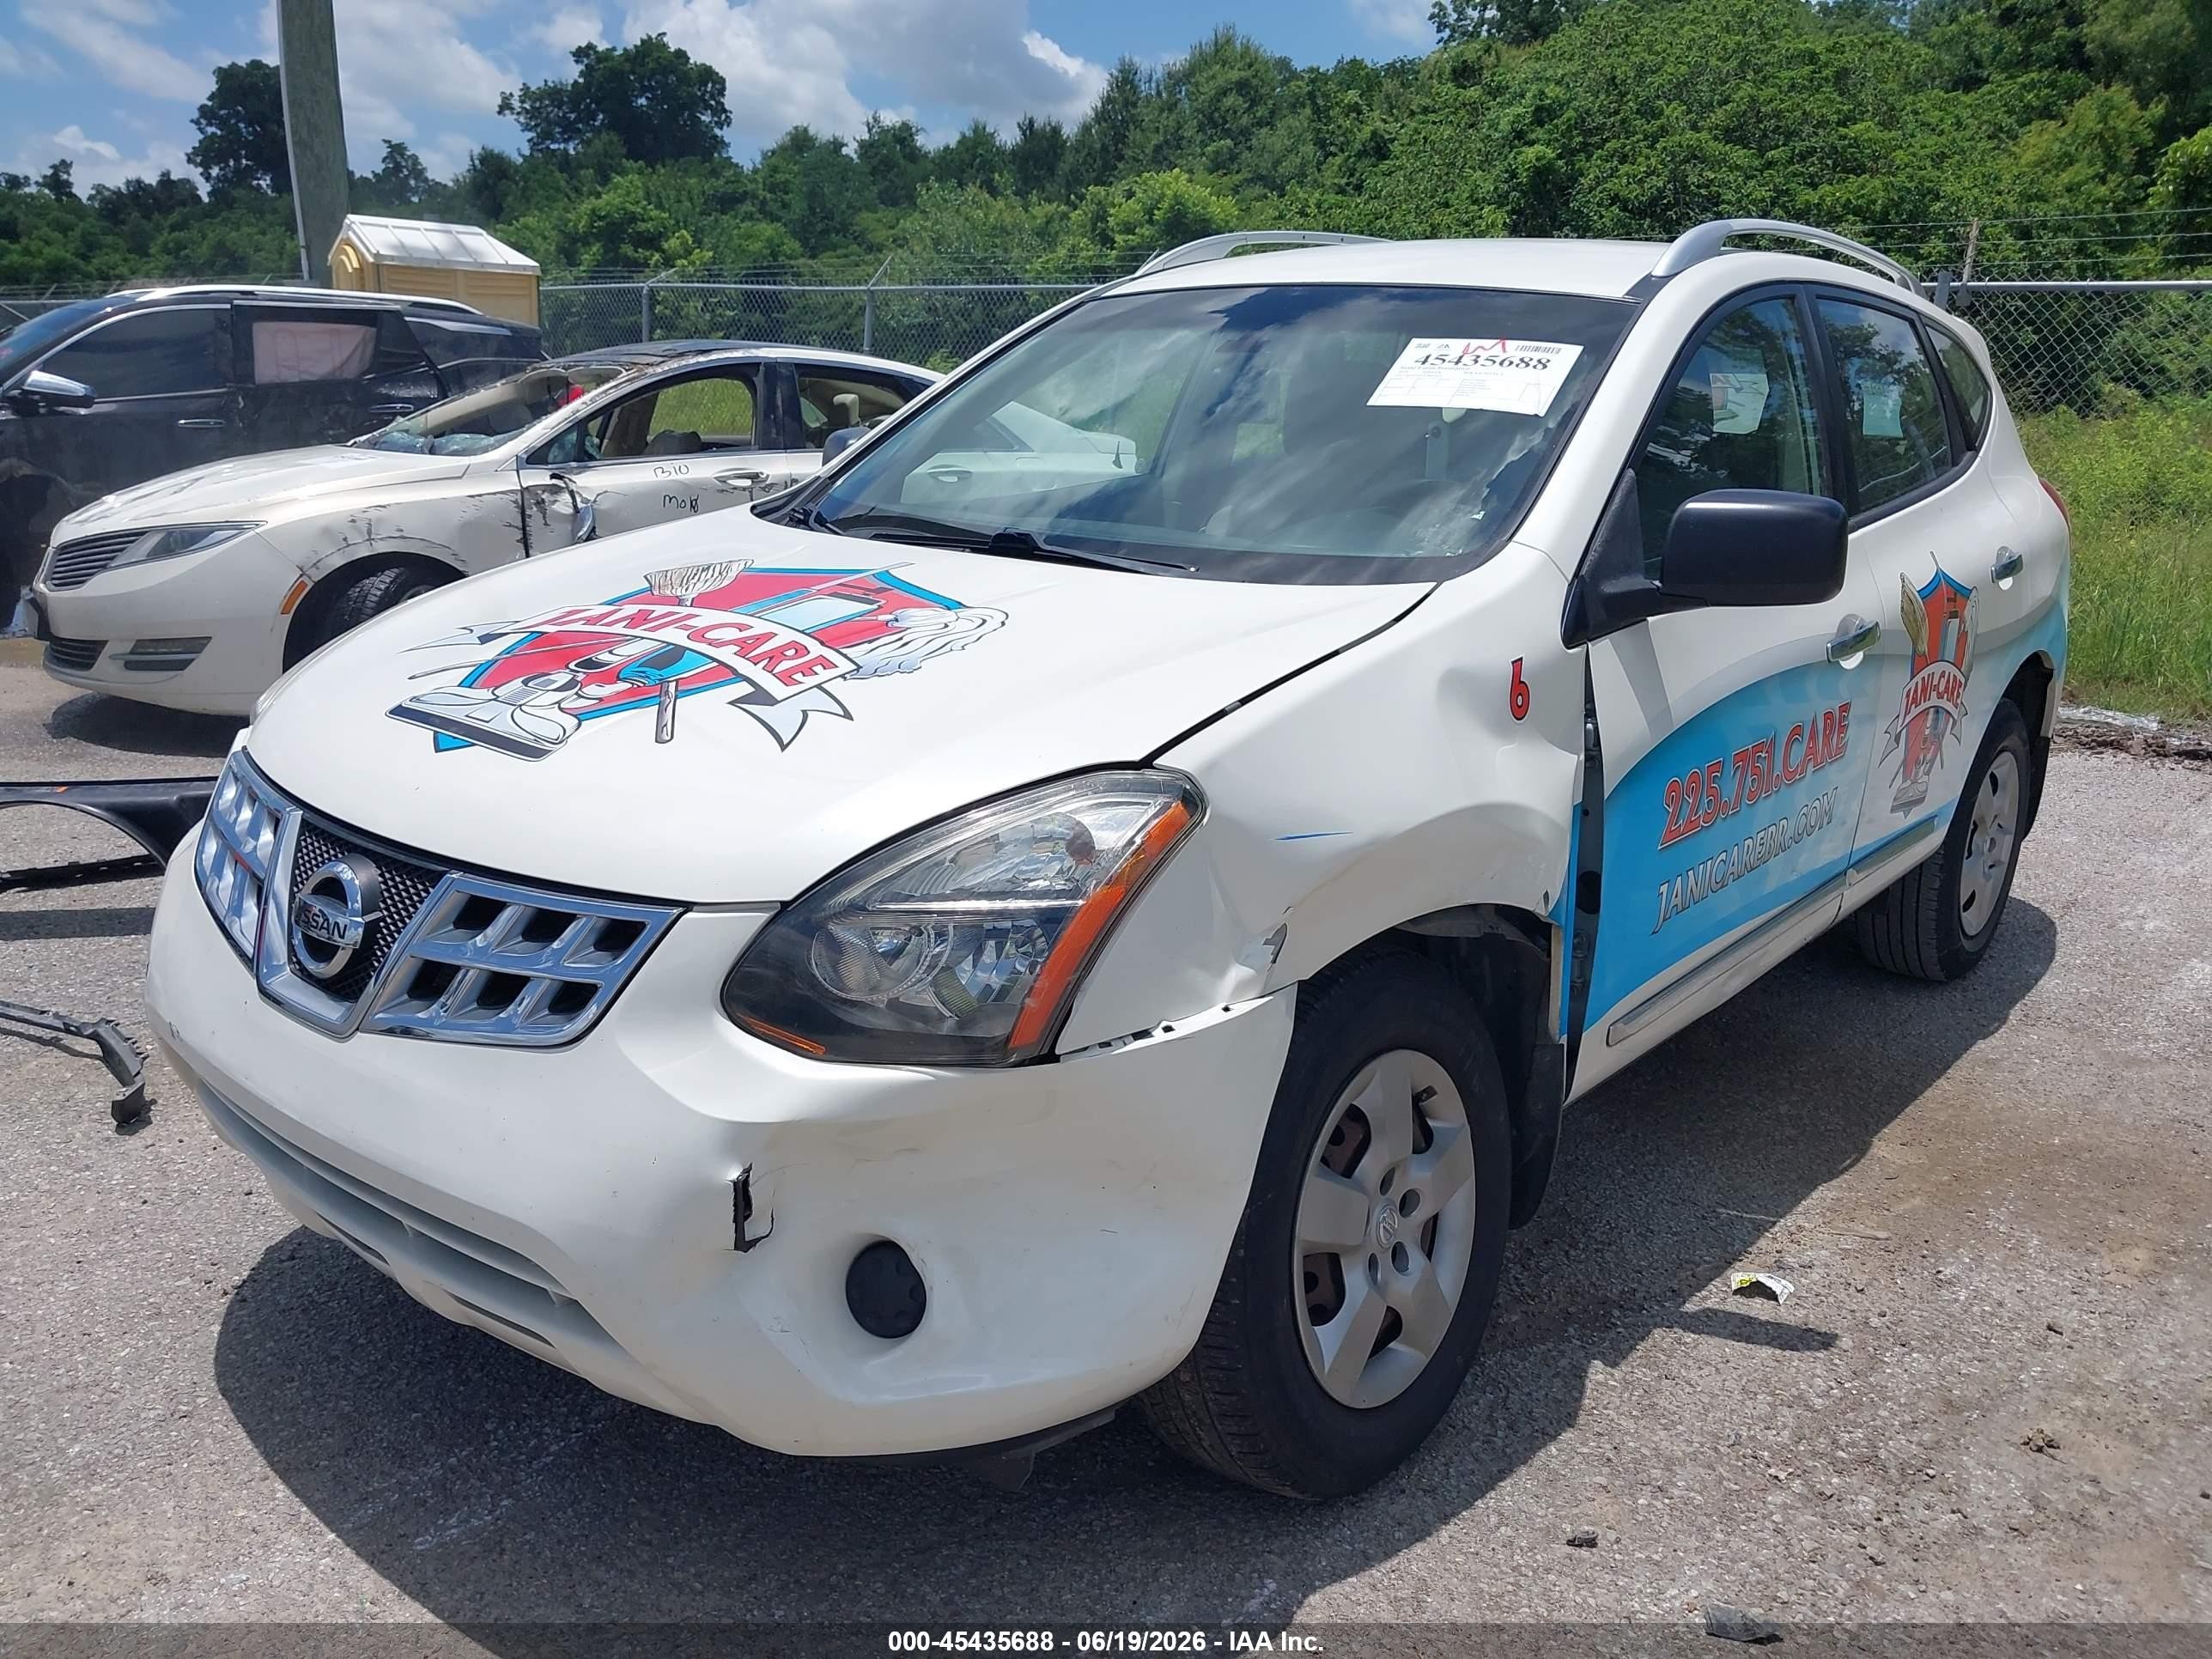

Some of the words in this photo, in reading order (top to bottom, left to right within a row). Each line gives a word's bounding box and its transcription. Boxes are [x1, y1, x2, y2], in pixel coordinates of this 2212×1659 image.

[1414, 353, 1552, 371] 45435688
[511, 608, 840, 687] JANI-CARE
[1510, 656, 1531, 721] 6
[1902, 670, 1963, 725] JANI-CARE
[1657, 701, 1852, 850] 225.751.CARE
[1650, 787, 1839, 935] JANICAREBR.COM
